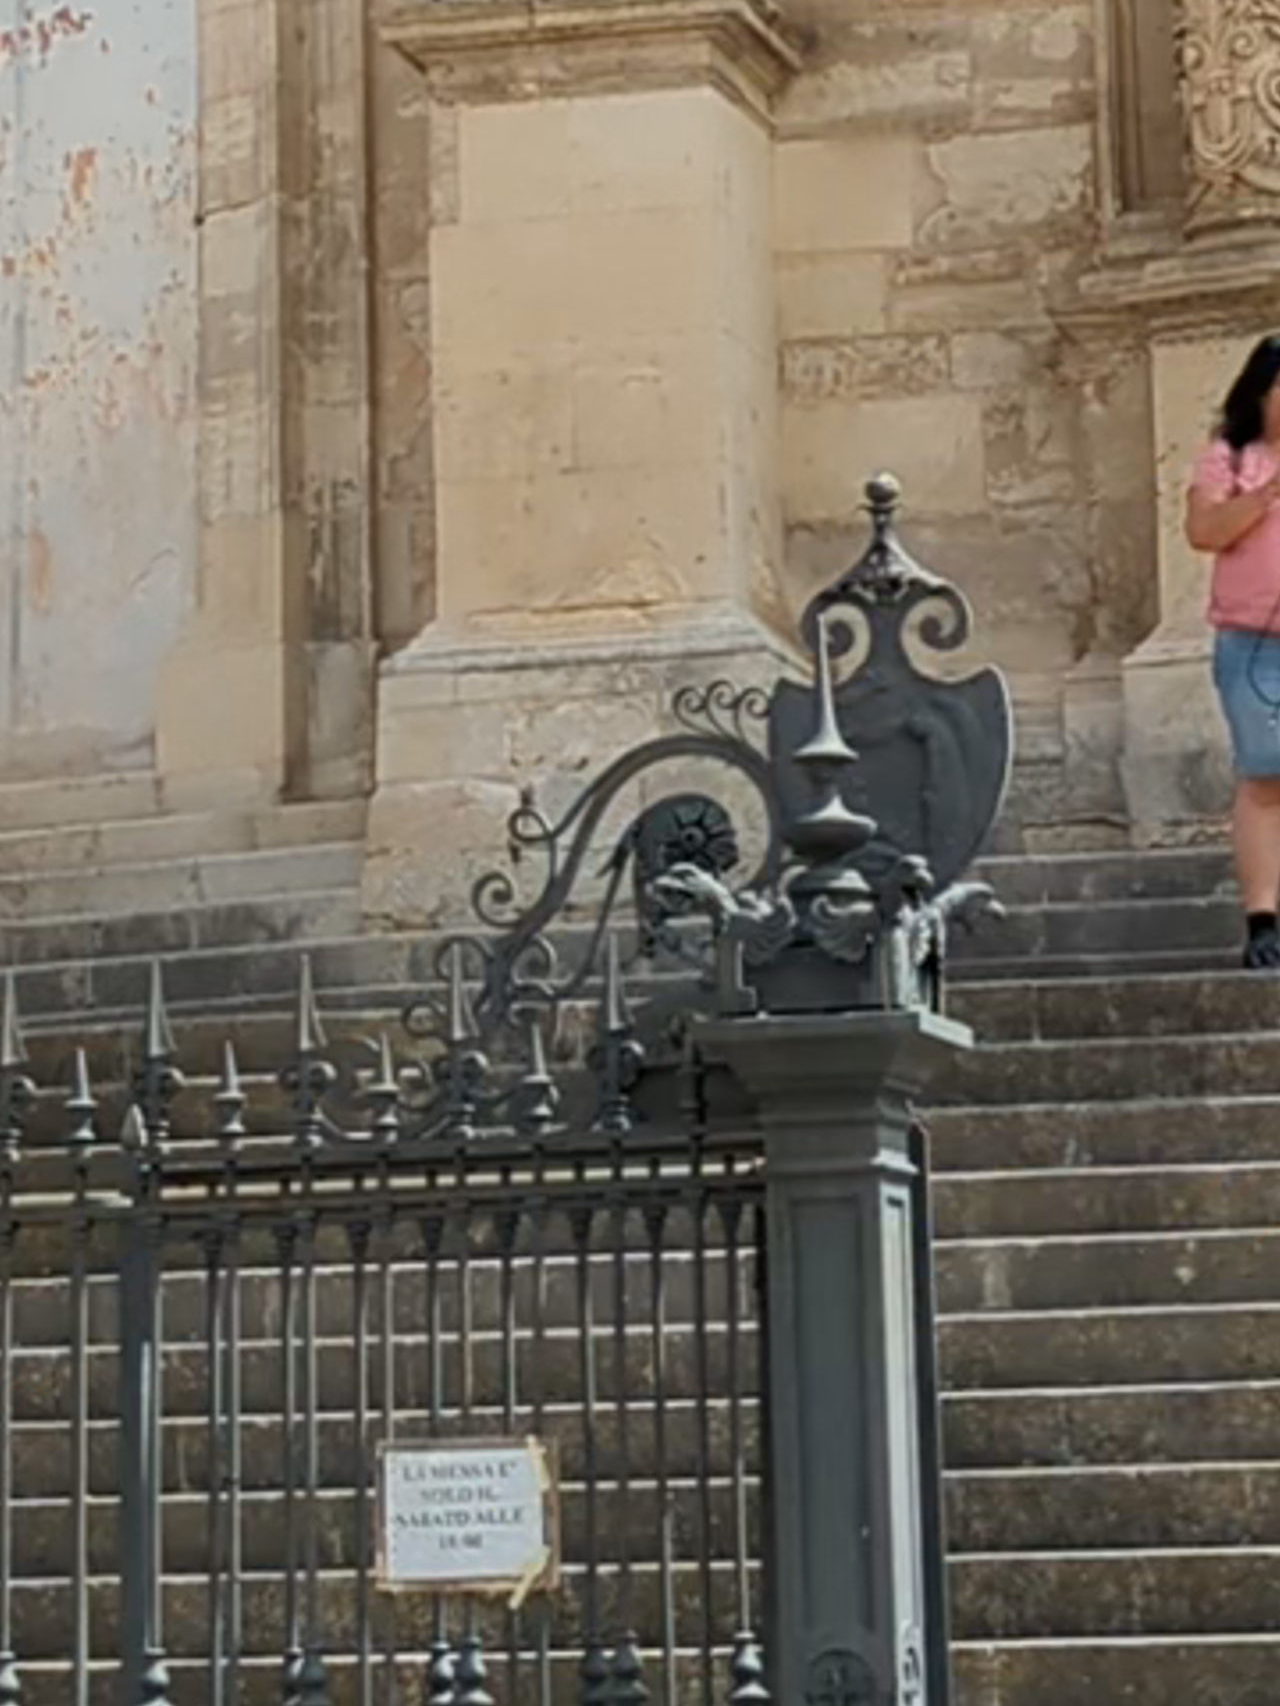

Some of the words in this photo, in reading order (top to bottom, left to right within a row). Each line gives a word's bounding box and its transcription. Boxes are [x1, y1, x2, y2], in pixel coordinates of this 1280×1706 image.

[420, 1486, 472, 1505] SOLO
[477, 1484, 501, 1502] IL
[395, 1508, 470, 1529] SABATO
[475, 1505, 525, 1525] ALLE
